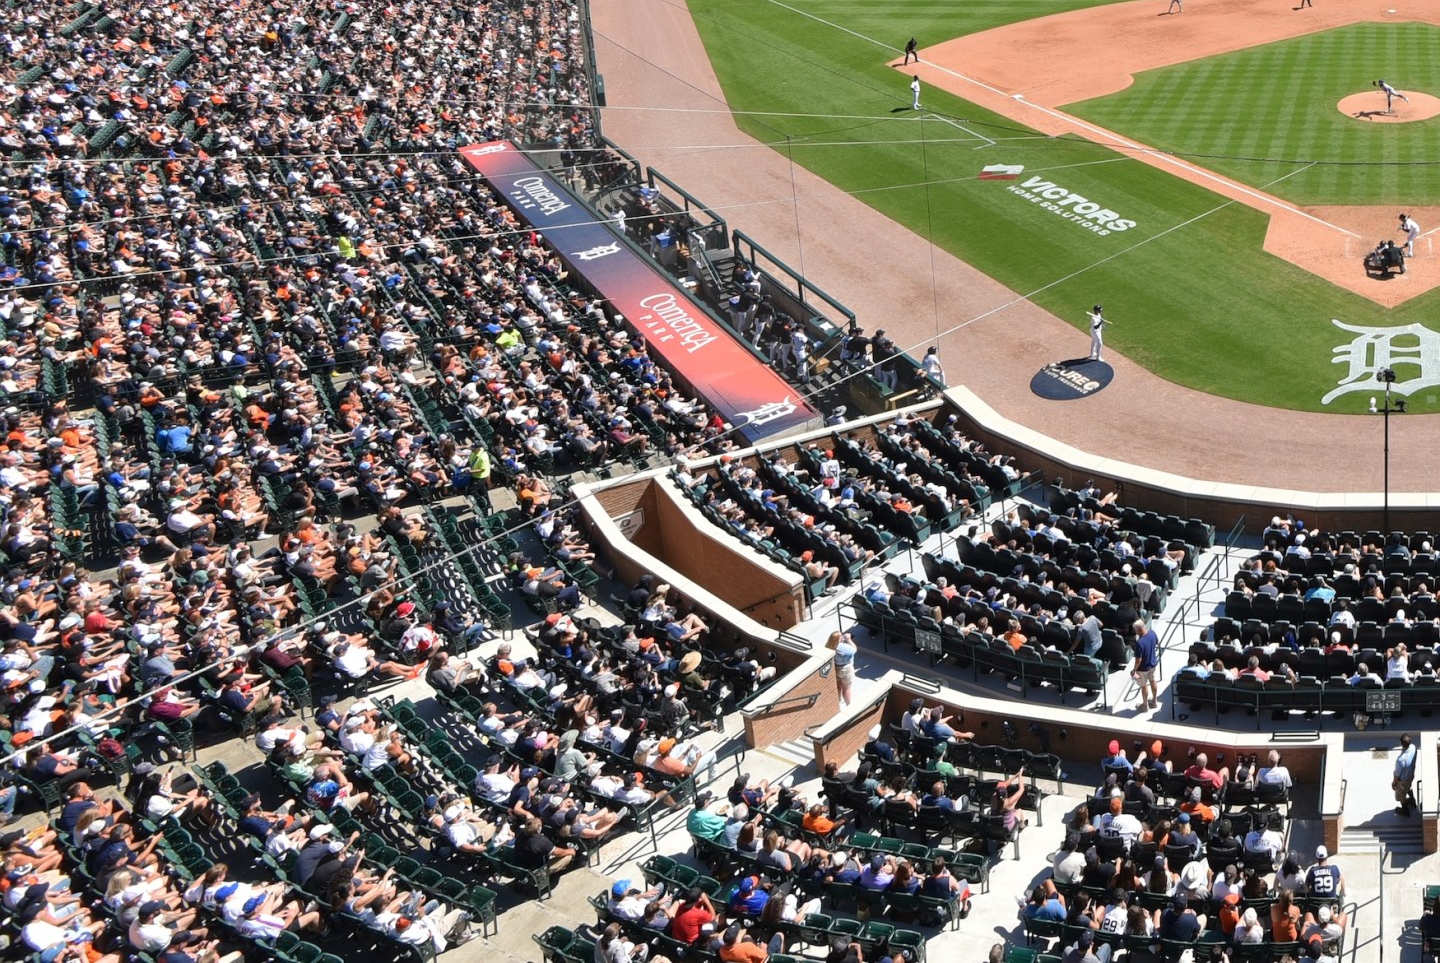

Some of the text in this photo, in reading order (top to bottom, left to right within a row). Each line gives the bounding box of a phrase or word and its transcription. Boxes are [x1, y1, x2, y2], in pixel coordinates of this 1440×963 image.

[510, 191, 536, 209] PARK
[1007, 185, 1110, 236] HOME SOLUTIONS
[1021, 176, 1137, 231] VICTORS
[639, 314, 675, 344] PARK
[1314, 876, 1333, 892] 29
[1104, 919, 1118, 932] 29
